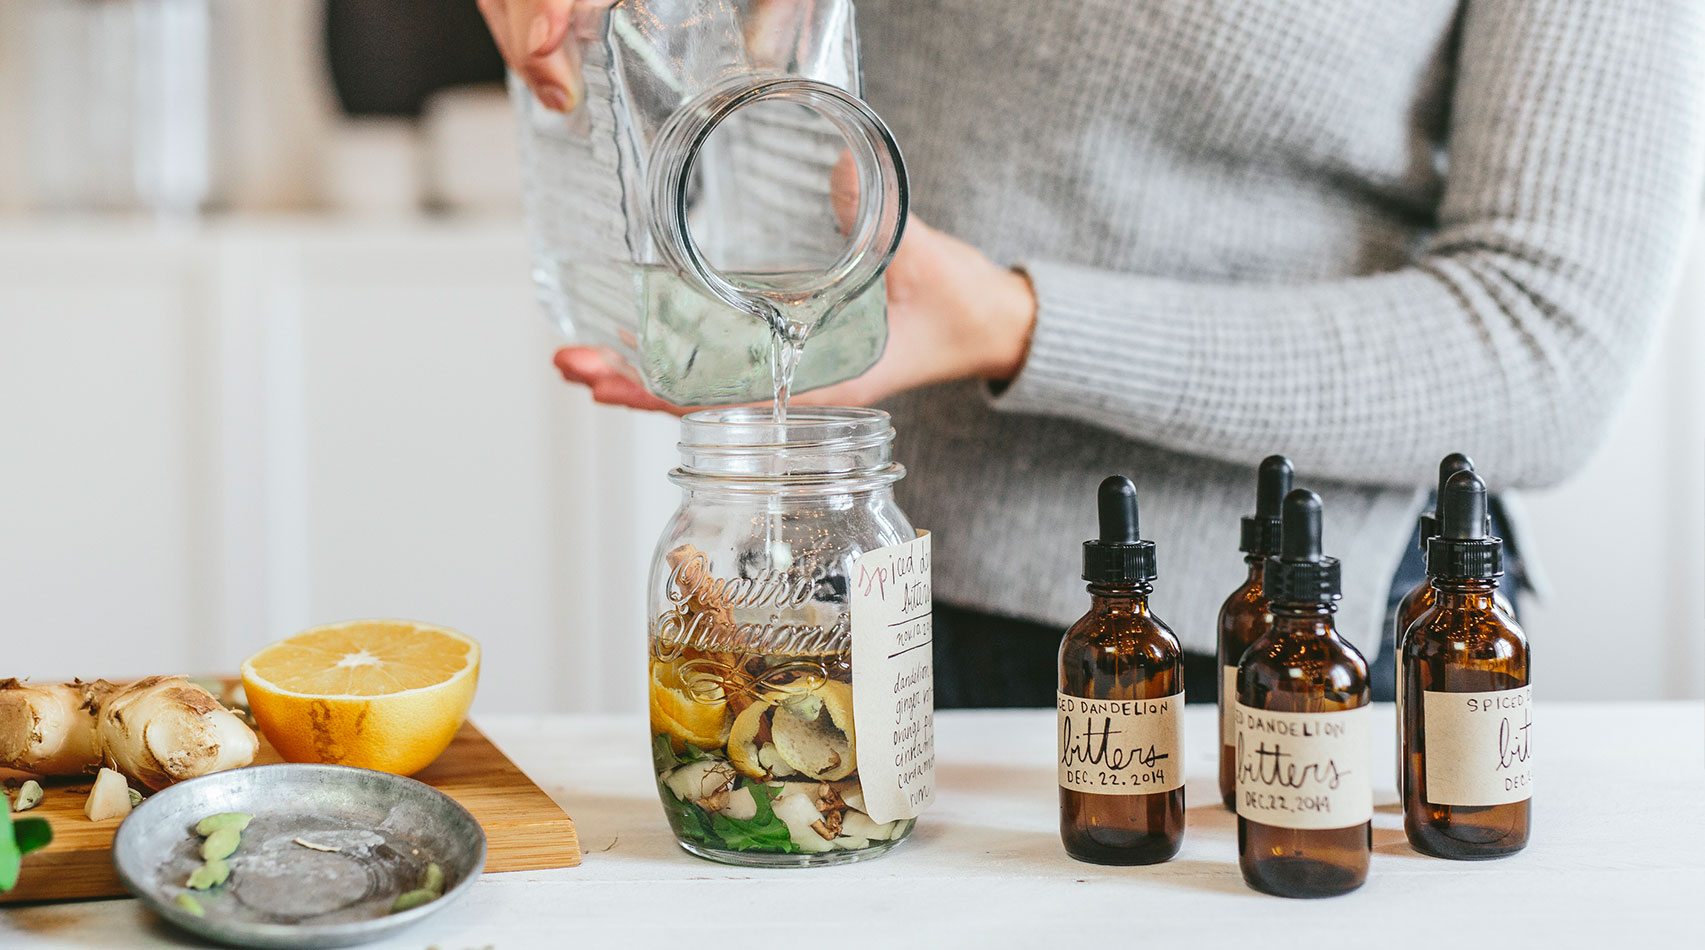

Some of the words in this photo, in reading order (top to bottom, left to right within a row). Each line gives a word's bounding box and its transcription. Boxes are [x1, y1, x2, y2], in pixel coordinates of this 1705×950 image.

[858, 543, 914, 600] spiced
[1081, 701, 1168, 716] DANDELION
[1466, 694, 1524, 713] SPICED
[893, 720, 920, 751] orange
[1247, 714, 1345, 738] DANDELION
[1061, 715, 1169, 771] bitters
[1236, 731, 1352, 790] bitters
